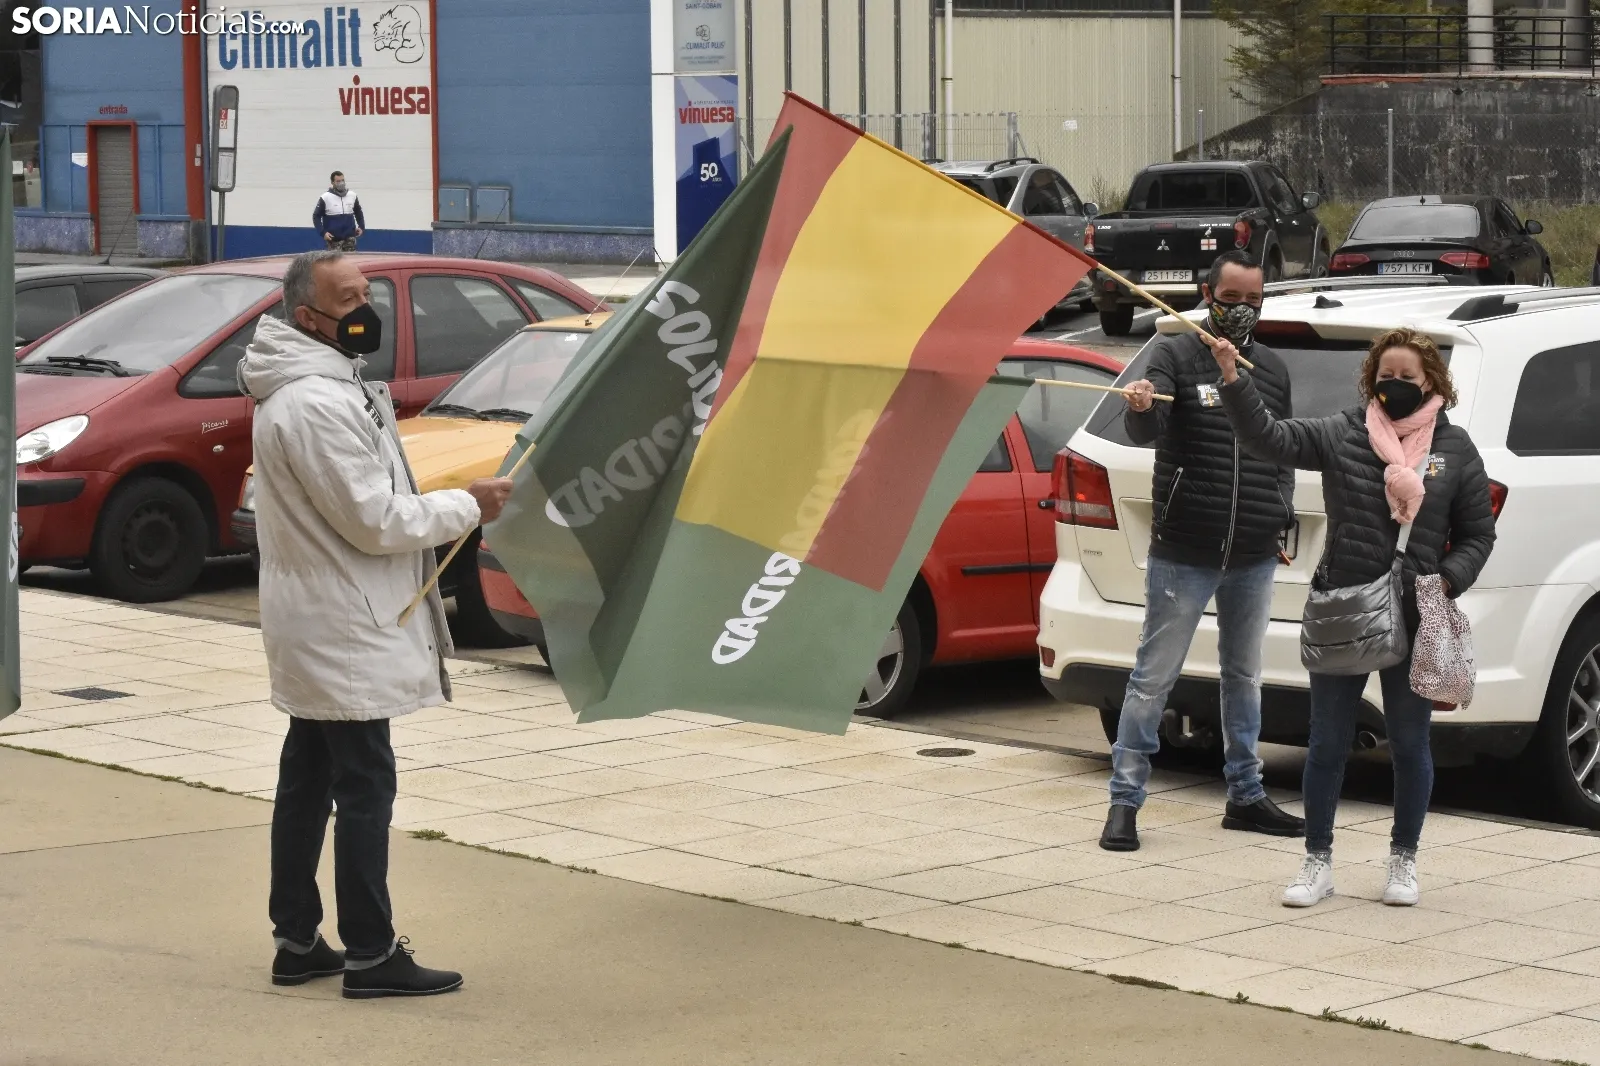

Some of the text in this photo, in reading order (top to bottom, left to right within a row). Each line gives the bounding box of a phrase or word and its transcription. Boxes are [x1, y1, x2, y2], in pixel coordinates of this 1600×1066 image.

[219, 7, 363, 70] climalit
[339, 75, 431, 116] vinuesa
[99, 104, 128, 115] entrada
[679, 101, 735, 124] vinuesa
[700, 162, 719, 181] 50
[1147, 270, 1190, 281] 2511 FSF
[1384, 263, 1431, 272] 7571 KFW
